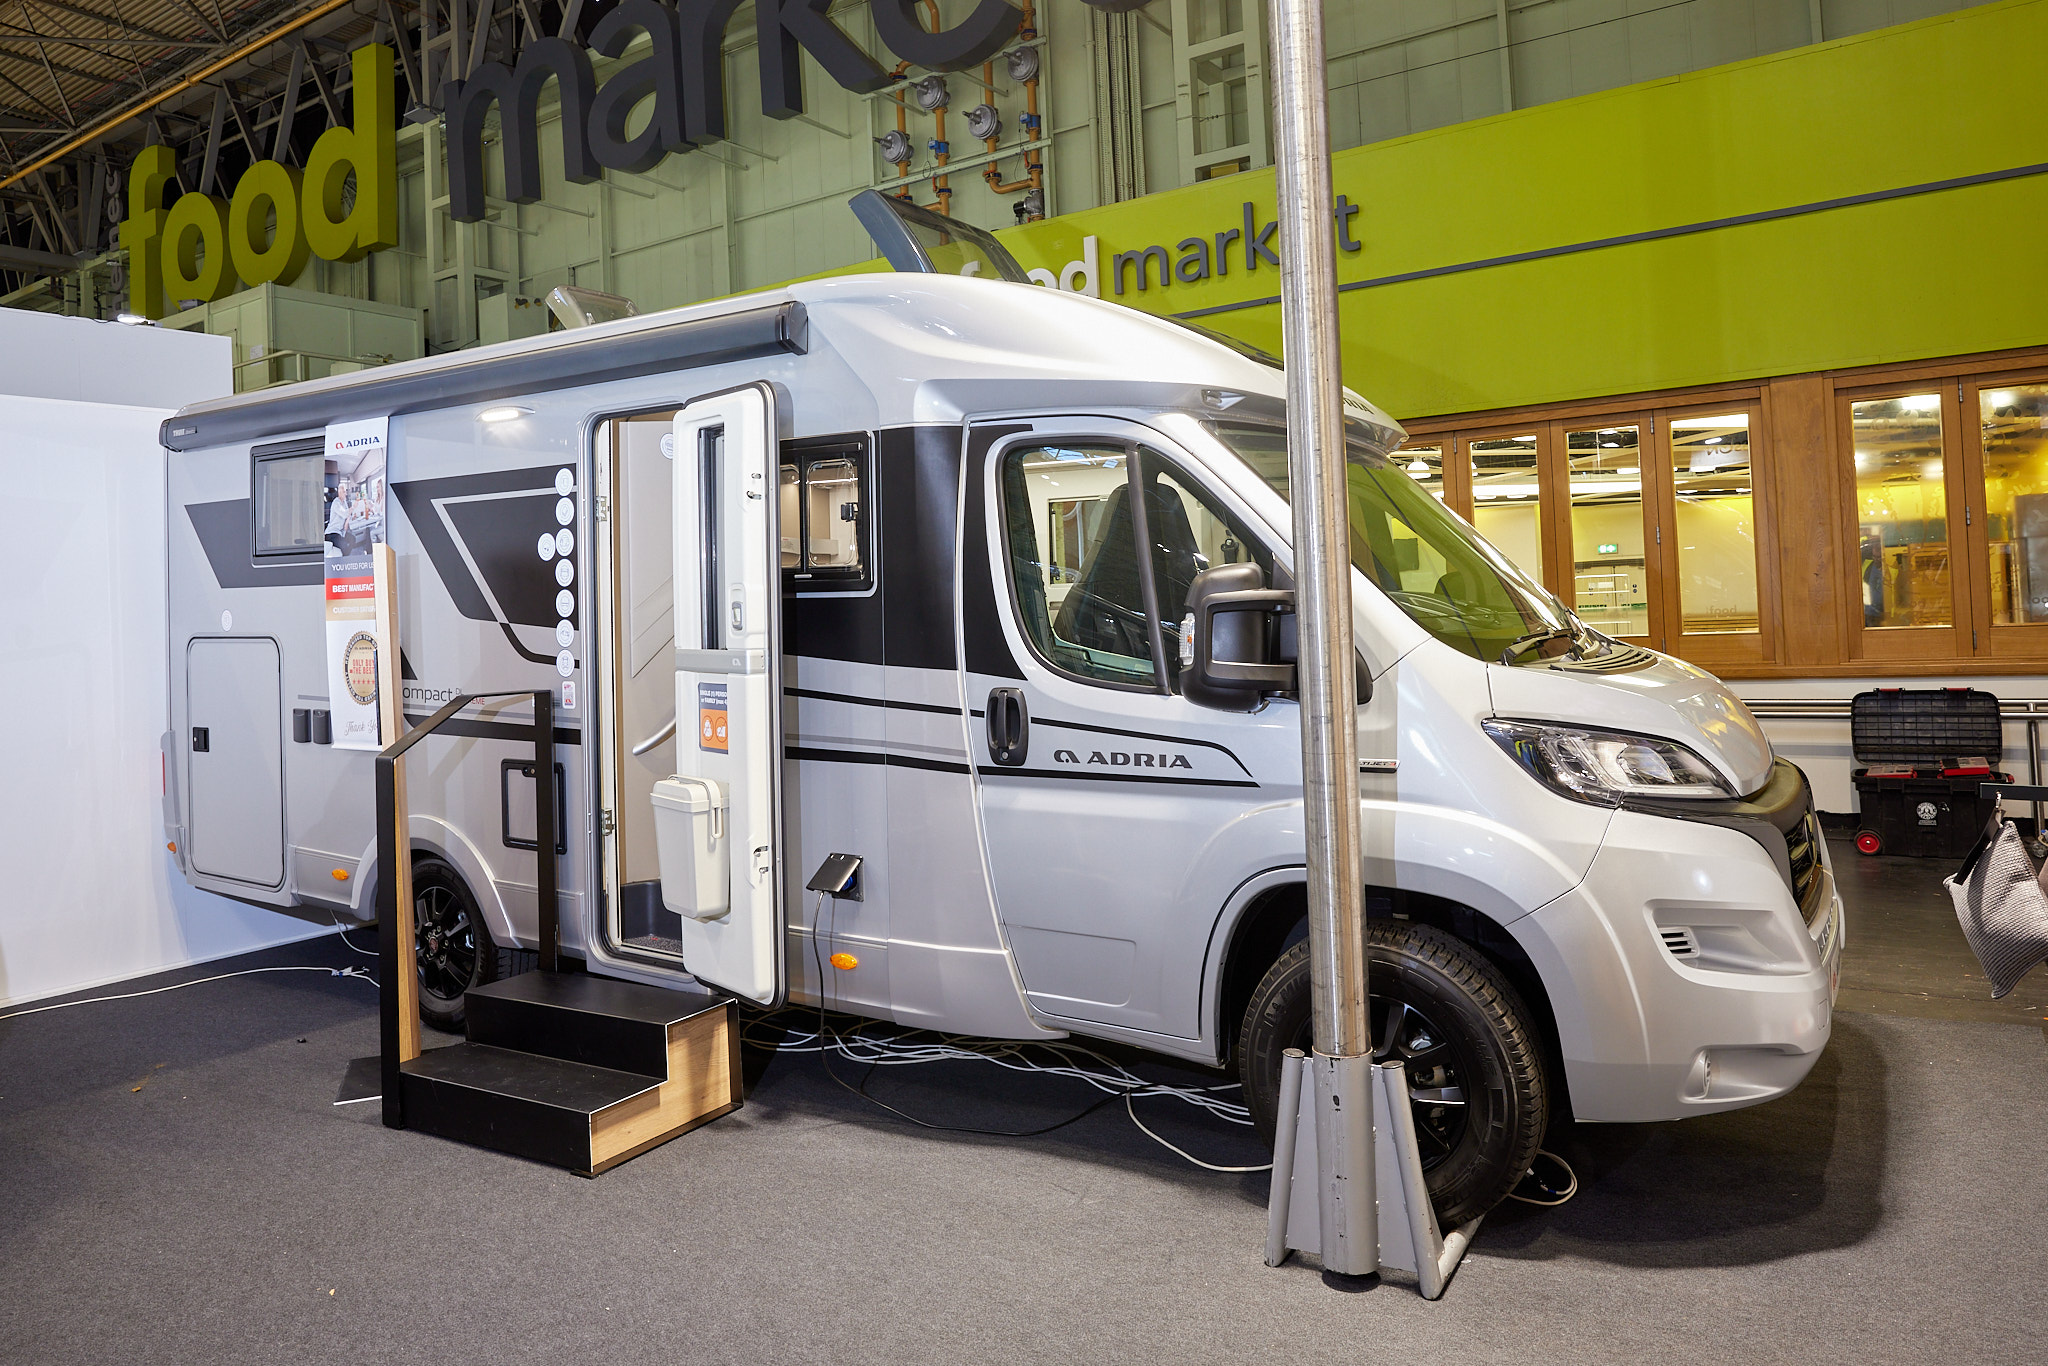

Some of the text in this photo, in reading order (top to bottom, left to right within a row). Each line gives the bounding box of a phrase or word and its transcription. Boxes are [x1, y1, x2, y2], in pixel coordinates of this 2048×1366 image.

[119, 43, 398, 320] food
[1113, 194, 1361, 296] markt
[346, 436, 380, 448] ADRIA
[331, 563, 344, 571] YOU
[345, 562, 358, 570] VOTED
[359, 561, 368, 569] FOR
[332, 583, 375, 593] BEST MANUFAC
[353, 659, 364, 667] ONLY
[402, 687, 453, 704] ompact
[1087, 751, 1193, 769] ADRIA
